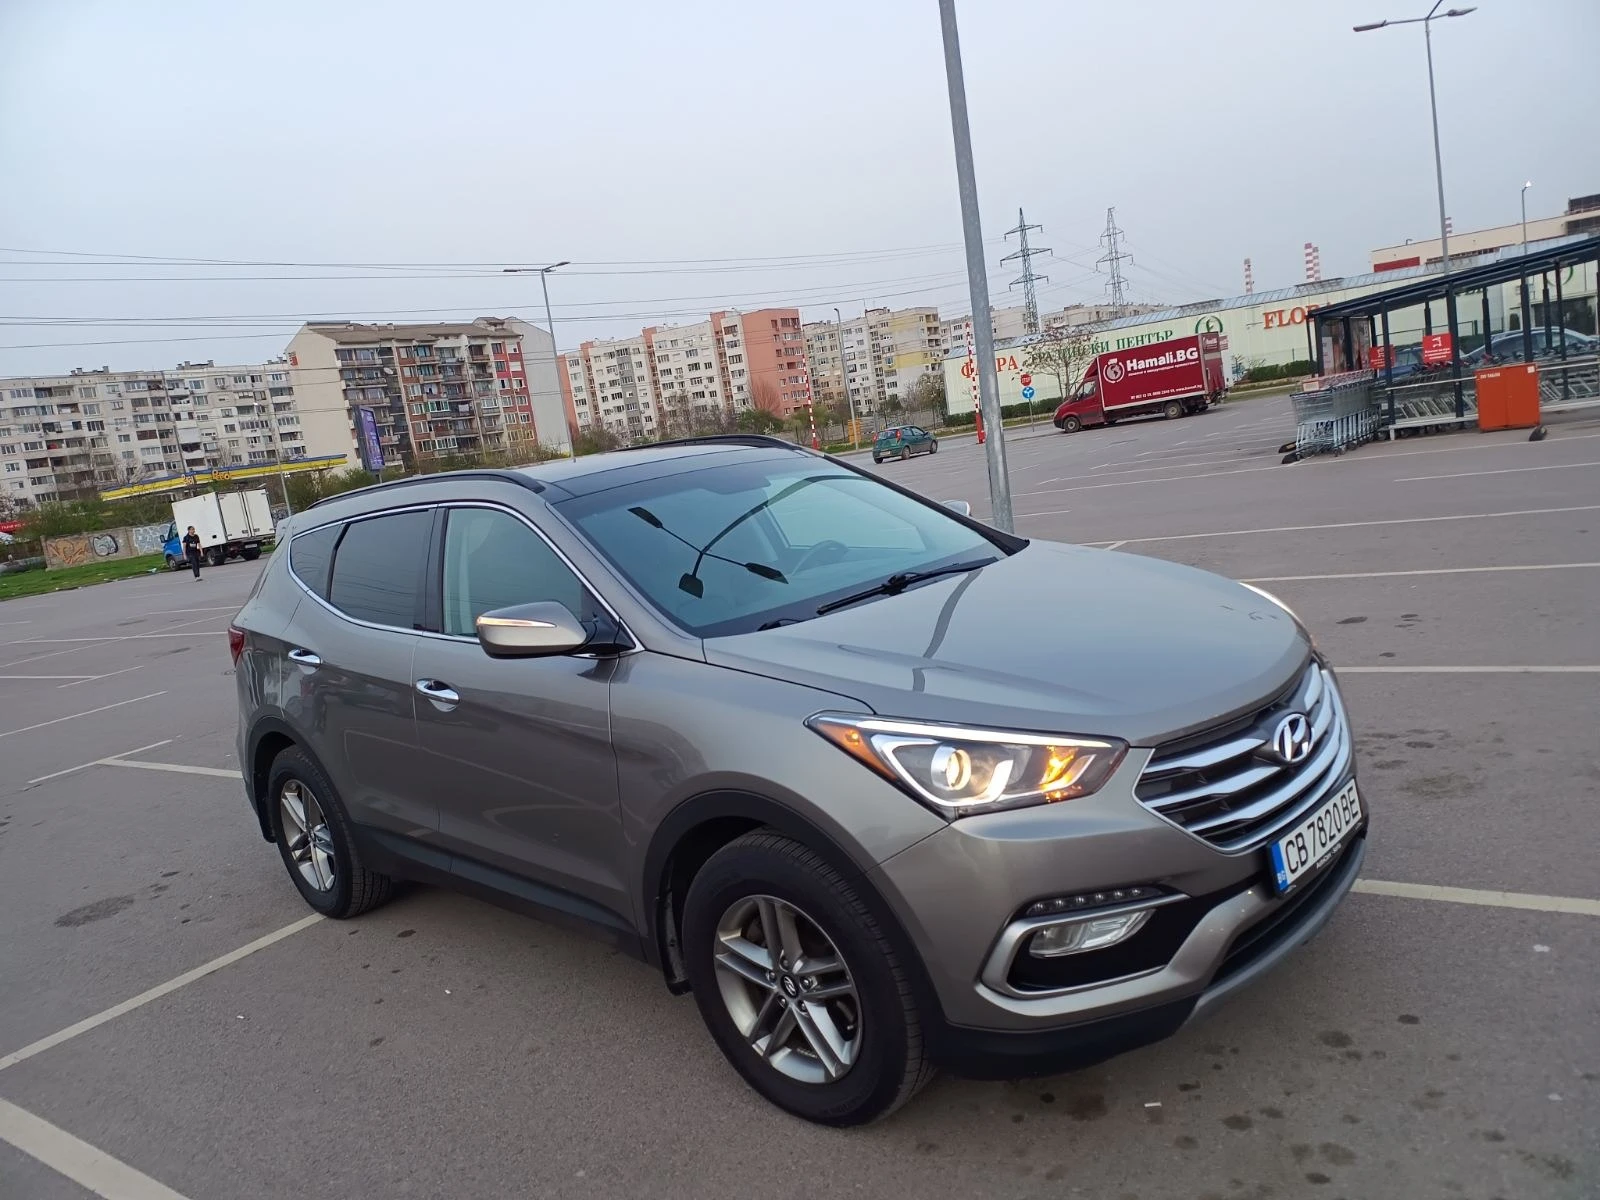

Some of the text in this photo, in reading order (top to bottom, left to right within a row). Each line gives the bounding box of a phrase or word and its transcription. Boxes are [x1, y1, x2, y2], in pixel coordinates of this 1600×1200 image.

[1263, 302, 1332, 329] FLO
[961, 355, 1019, 378] ФРА
[1127, 347, 1198, 371] Hamali.BG
[1285, 832, 1309, 875] CB
[1307, 802, 1342, 858] 7820
[1340, 786, 1359, 827] BE
